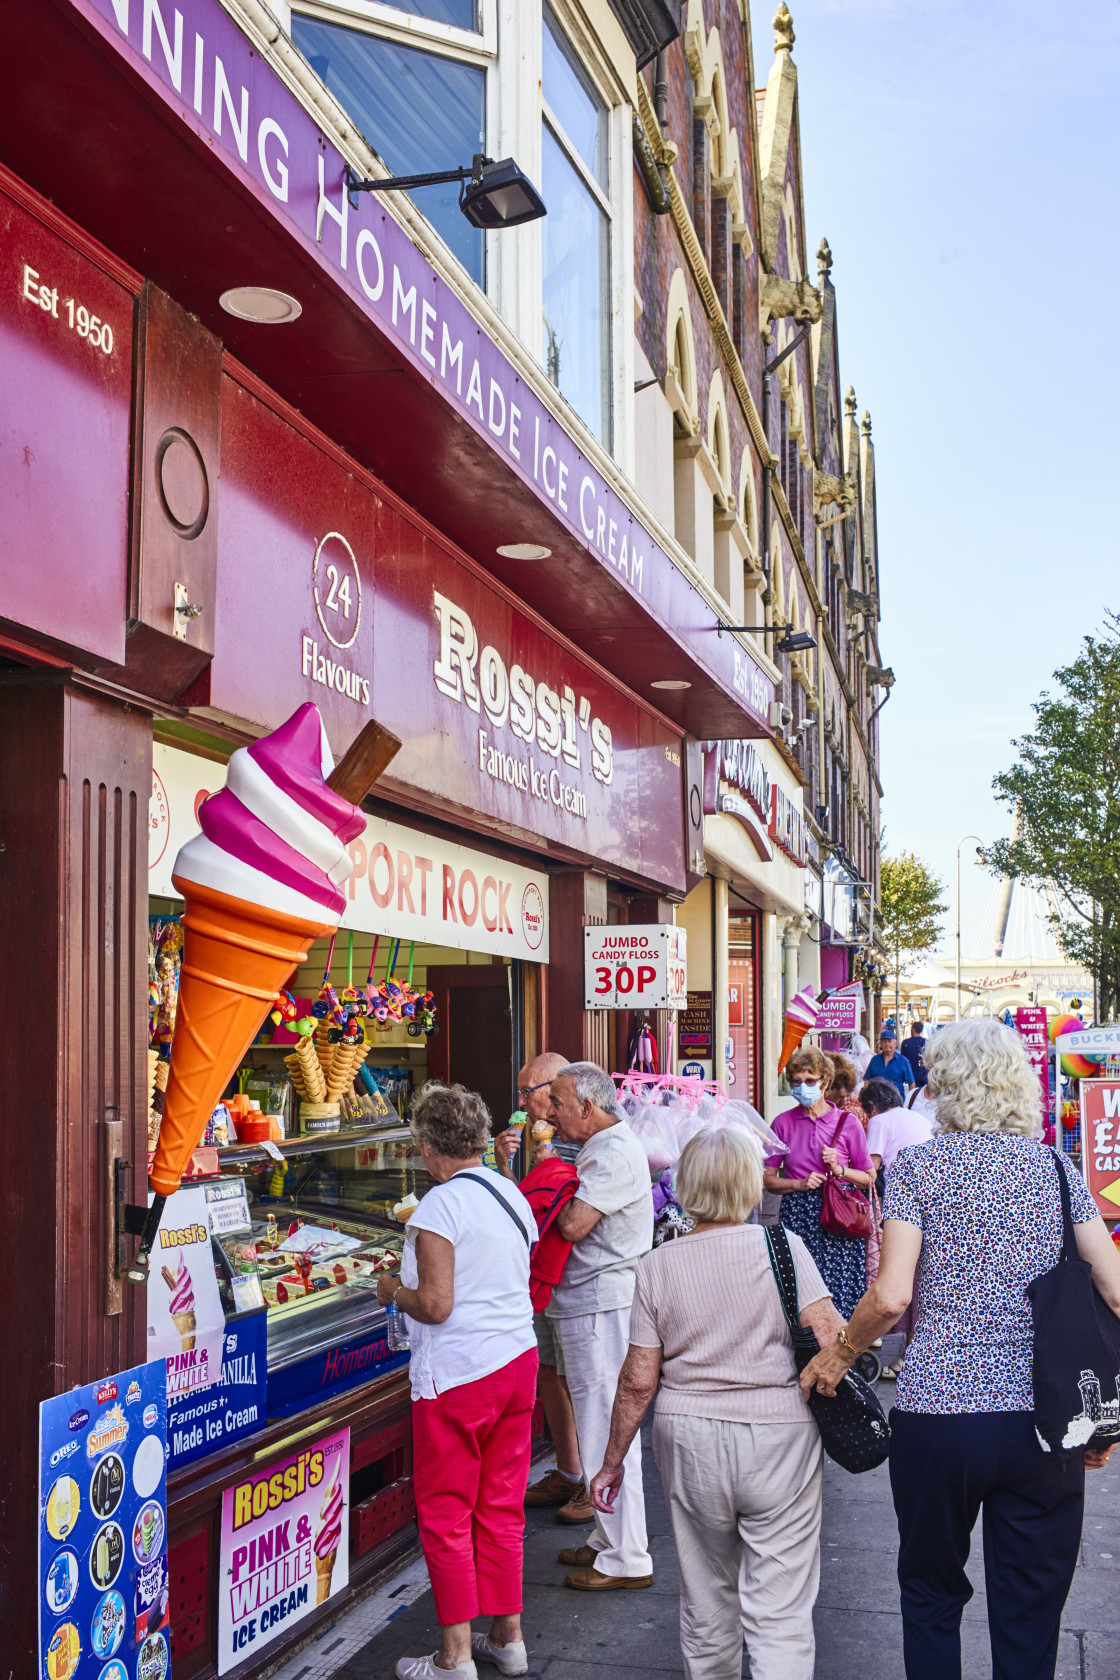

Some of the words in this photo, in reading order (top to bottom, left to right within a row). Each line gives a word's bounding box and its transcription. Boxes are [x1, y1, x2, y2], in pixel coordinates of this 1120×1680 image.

[24, 264, 59, 318] Est
[65, 298, 114, 354] 1950
[325, 564, 352, 618] 24
[301, 635, 370, 705] Flavours
[478, 729, 528, 794] Famous
[529, 757, 548, 800] Ice
[548, 768, 587, 818] Cream
[442, 863, 514, 935] ROCK
[592, 951, 627, 960] CANDY
[629, 950, 659, 960] FLOSS
[601, 936, 649, 948] JUMBO
[594, 965, 657, 994] 30P
[685, 1065, 702, 1074] WAY
[160, 1224, 207, 1249] Rossi's
[166, 1348, 198, 1375] PINK
[199, 1348, 209, 1363] &
[166, 1362, 208, 1395] WHITE
[216, 1352, 258, 1388] ANILLA
[169, 1399, 218, 1428] Famous
[173, 1424, 204, 1457] Made
[206, 1418, 223, 1442] Ice
[225, 1404, 258, 1432] Cream
[50, 1441, 78, 1466] OREO
[89, 1425, 128, 1455] Summer
[232, 1449, 325, 1532] Rossi's
[231, 1518, 291, 1584] PINK
[295, 1513, 312, 1545] &
[229, 1539, 312, 1624] WHITE
[232, 1618, 257, 1653] ICE
[260, 1583, 309, 1634] CREAM
